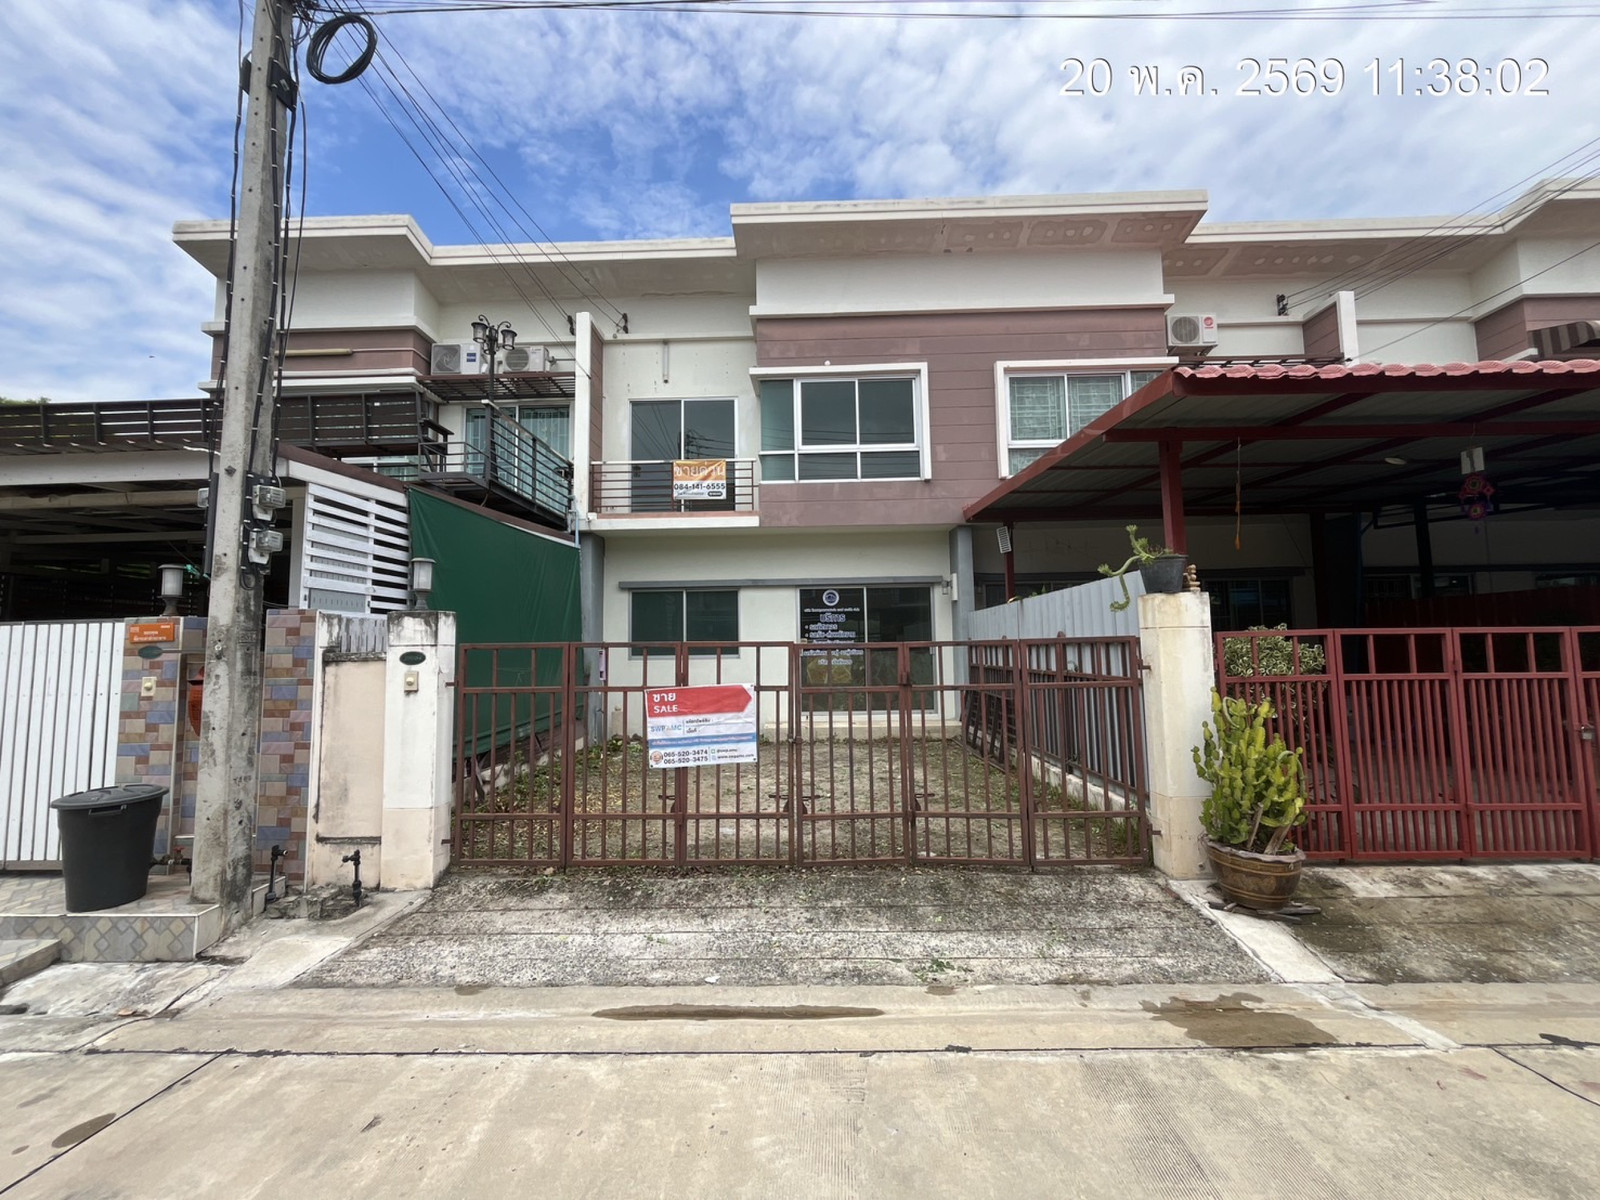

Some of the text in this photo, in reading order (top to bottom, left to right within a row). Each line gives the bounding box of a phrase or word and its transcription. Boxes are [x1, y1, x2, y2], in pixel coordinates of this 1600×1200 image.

[653, 693, 676, 703] ขาย
[654, 705, 678, 713] SALE
[664, 750, 708, 758] 065-520-3474
[664, 756, 709, 765] 065-520-3475
